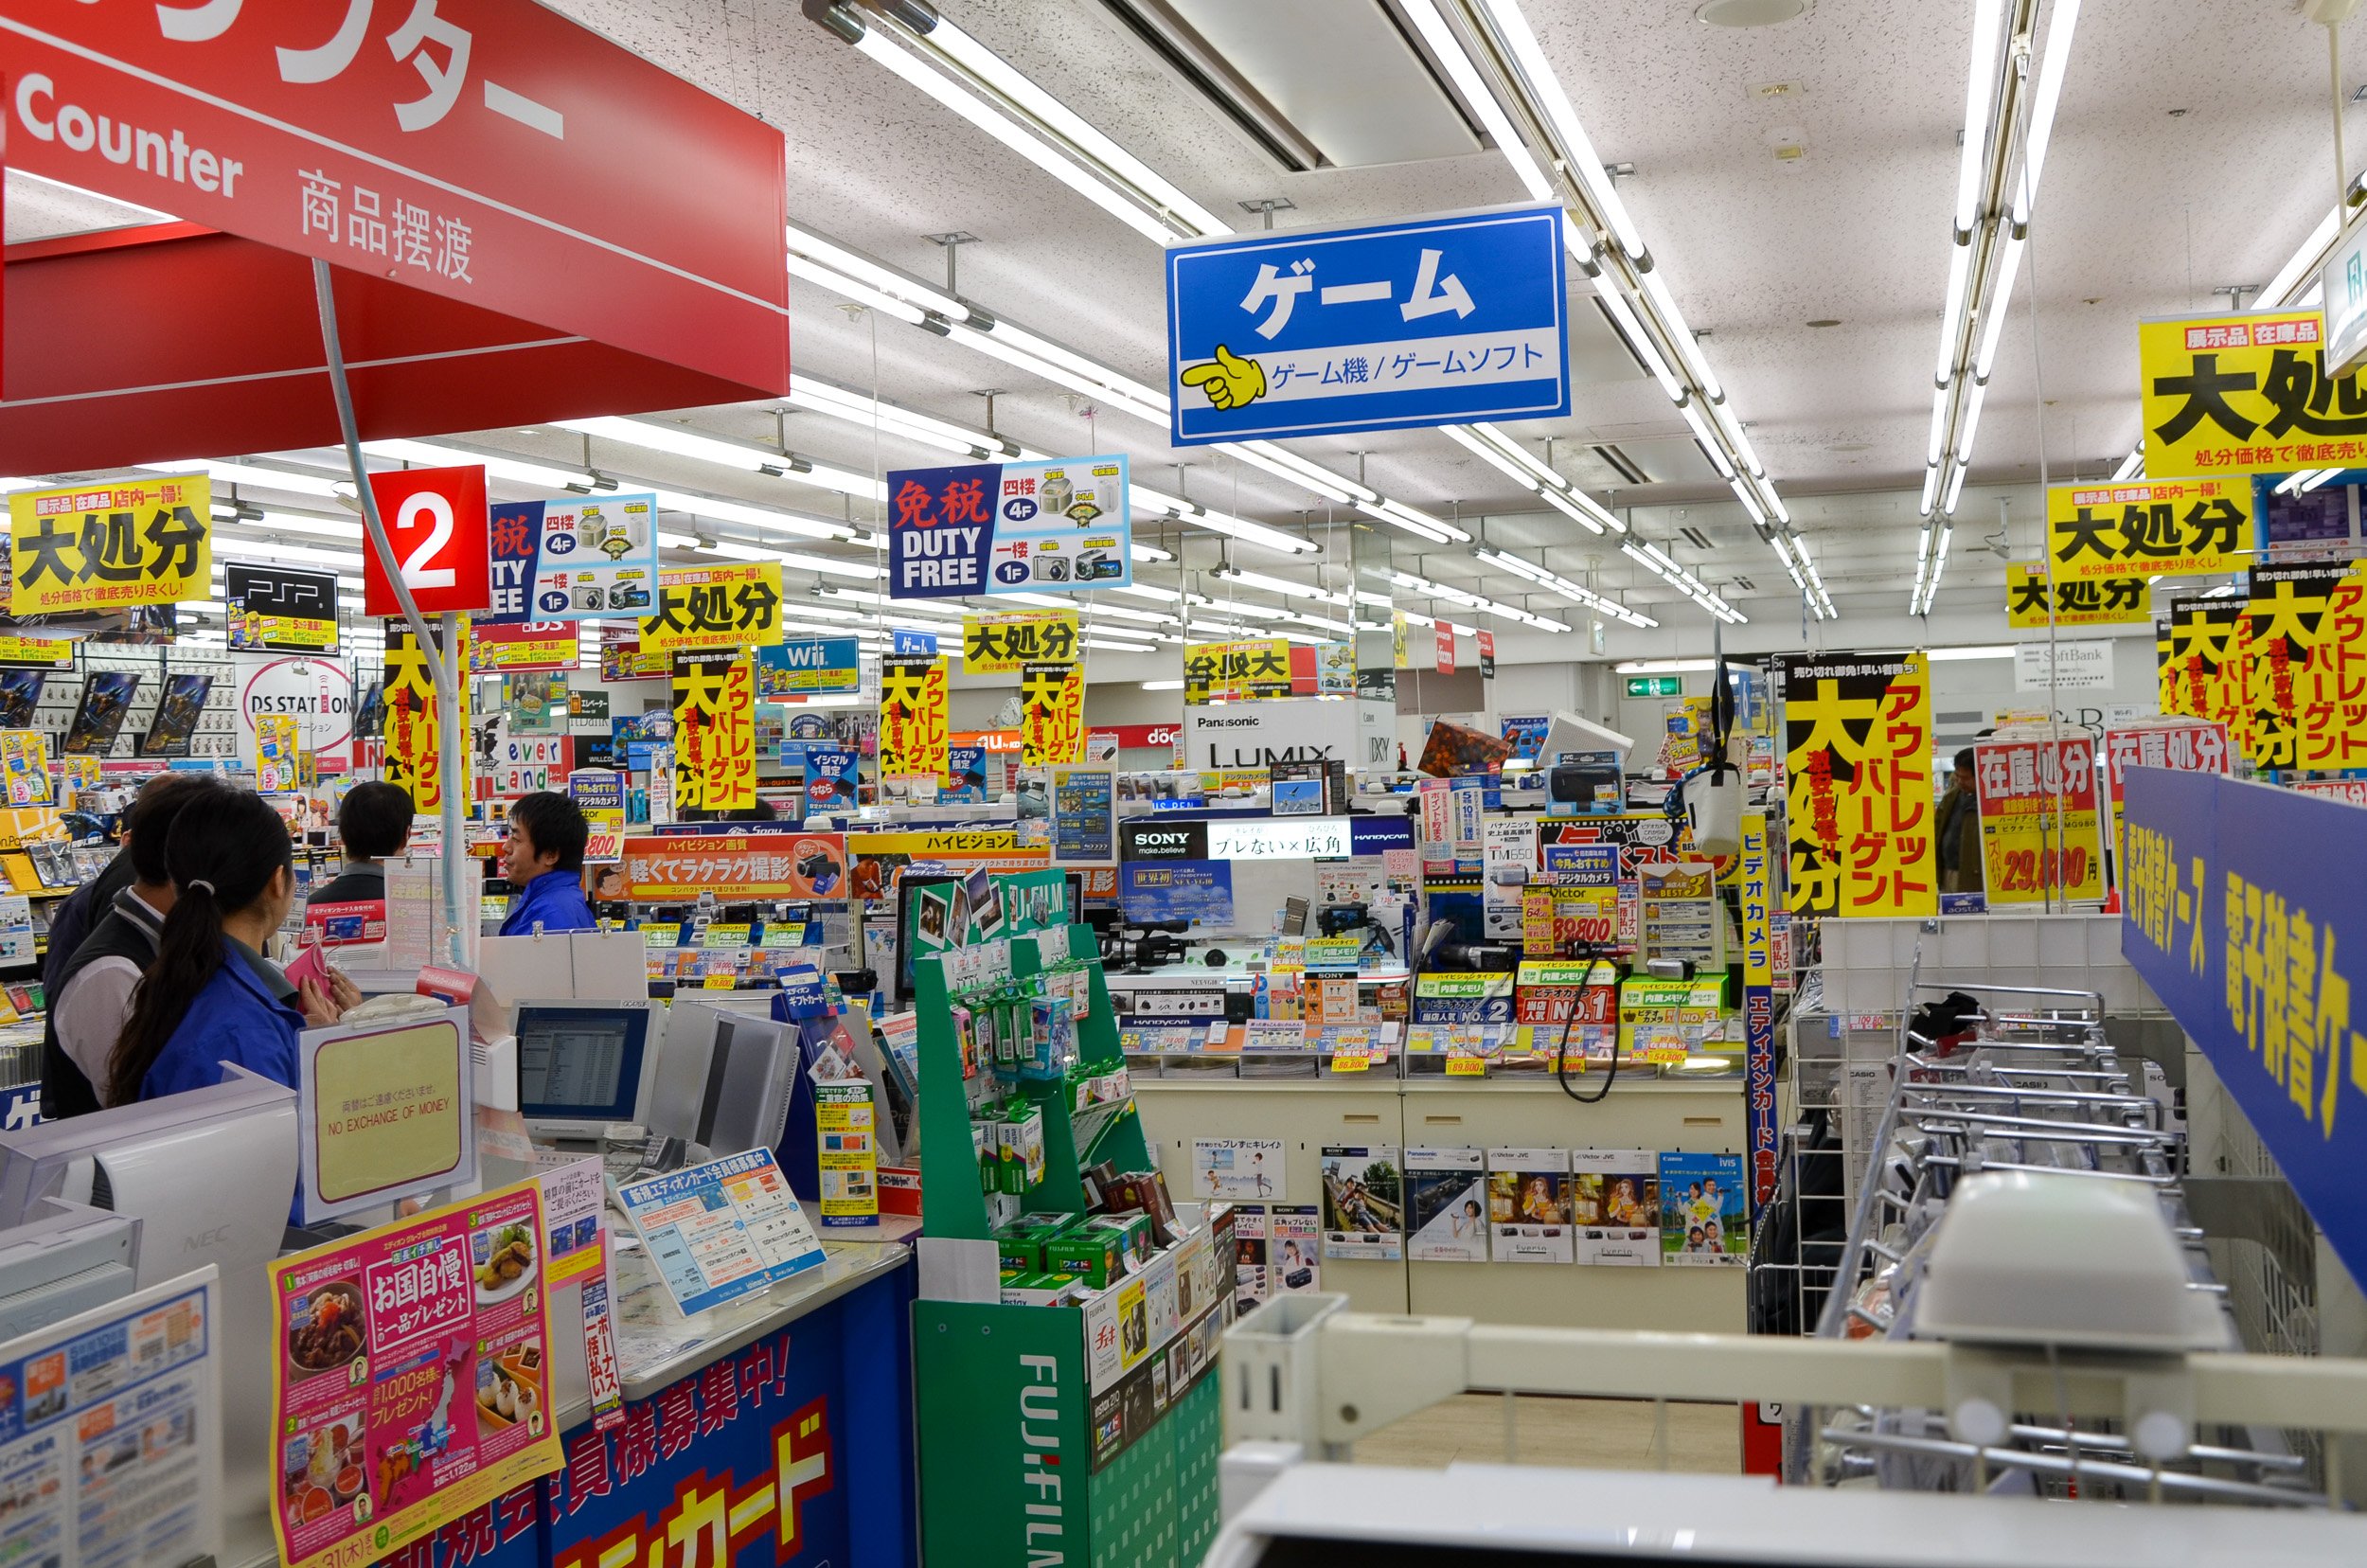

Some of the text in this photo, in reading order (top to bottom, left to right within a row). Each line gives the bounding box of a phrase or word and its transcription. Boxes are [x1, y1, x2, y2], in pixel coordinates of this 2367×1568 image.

[15, 72, 243, 199] Counter
[298, 169, 473, 284] 商品摆渡
[1239, 248, 1476, 340] ゲーム
[2185, 322, 2318, 348] 展示品 在庫品
[1004, 478, 1036, 497] 四楼
[2073, 484, 2221, 505] 展示品 在庫品 店内一掃!
[36, 485, 183, 515] 展示品 在庫品 店内一掃!
[894, 478, 990, 529] 免税
[1009, 502, 1032, 518] 4F
[546, 514, 575, 531] 四楼
[2055, 498, 2247, 563] 大処分
[18, 506, 207, 590] 大処分
[396, 490, 456, 590] 2
[551, 536, 571, 553] 4F
[902, 526, 982, 559] DUTY
[996, 541, 1028, 559] 一楼
[902, 556, 979, 589] FREE
[1004, 564, 1022, 581] 1F
[2079, 557, 2222, 576] 処分価格で徹底売り尽くし!
[2256, 567, 2362, 582] 売り切れ御免!早い者勝ち!
[248, 579, 318, 604] PSP
[540, 573, 568, 590] 一楼
[40, 583, 184, 604] 処分価格で徹底売り尽くし!
[546, 593, 564, 611] 1F
[2012, 575, 2146, 615] 大処分
[643, 581, 779, 636] 大処分
[659, 633, 762, 647] 処分価格で徹底売り尽くし!
[901, 636, 927, 654] ゲーム
[967, 623, 1076, 662] 大処分
[787, 645, 825, 667] Wii
[1794, 663, 1918, 679] 売り切れ御免!早い者勝ち!
[2333, 585, 2367, 760] アウトレット
[252, 696, 273, 713] DS
[2303, 644, 2336, 761] バーゲン
[1198, 716, 1260, 728] Panasonic
[727, 666, 752, 803] アウトレット
[976, 735, 1003, 750] au
[508, 741, 558, 761] ever
[707, 712, 731, 804] バーゲン
[812, 754, 849, 766] イシマル
[1209, 742, 1333, 769] LUMIX
[820, 765, 842, 777] 限定
[952, 759, 970, 771] 限定
[809, 783, 834, 795] 今なら
[1885, 685, 1928, 907] アウトレット
[578, 796, 618, 807] デジタルカメラ
[1806, 749, 1840, 863] 激安家電!!
[1134, 832, 1190, 846] SONY
[1848, 758, 1888, 906] バーゲン
[667, 838, 747, 851] ハイビジョン画質
[1216, 835, 1342, 855] ブレない×広角
[1489, 848, 1533, 861] TM650
[630, 856, 791, 883] 軽くてラクラク撮影
[1555, 858, 1610, 869] 今月のおすすめ
[1136, 872, 1170, 884] 世界初
[1558, 872, 1611, 882] デジタルカメラ
[1660, 875, 1706, 898] BEST 3
[1551, 887, 1587, 899] Victor
[1742, 831, 1767, 969] ビデオカメラ
[2127, 823, 2205, 979] 電子辞書ケース
[1619, 900, 1628, 935] 一括払い
[1628, 900, 1636, 935] ボーナス
[1541, 971, 1583, 982] 内蔵メモリ
[1440, 984, 1484, 993] 内蔵メモリ
[1534, 989, 1591, 998] ビデオカメラ
[788, 993, 826, 1007] ギフトカード
[1525, 1001, 1546, 1010] 当店
[1422, 1013, 1458, 1023] 当店人気
[1525, 1010, 1545, 1021] 人気
[1637, 1009, 1659, 1018] ビデオ
[342, 1083, 437, 1114] 両替はご遠慮くださいませ。
[328, 1096, 450, 1136] NO EXCHANGE OF MONEY
[629, 1151, 766, 1204] 新規エディオンカード会員様募集中
[470, 1213, 478, 1228] 3
[374, 1248, 466, 1314] お国自慢
[385, 1292, 467, 1335] 一品プレゼント
[585, 1323, 604, 1397] 一括払い
[596, 1314, 618, 1392] ボーナス
[372, 1387, 433, 1430] プレゼント!
